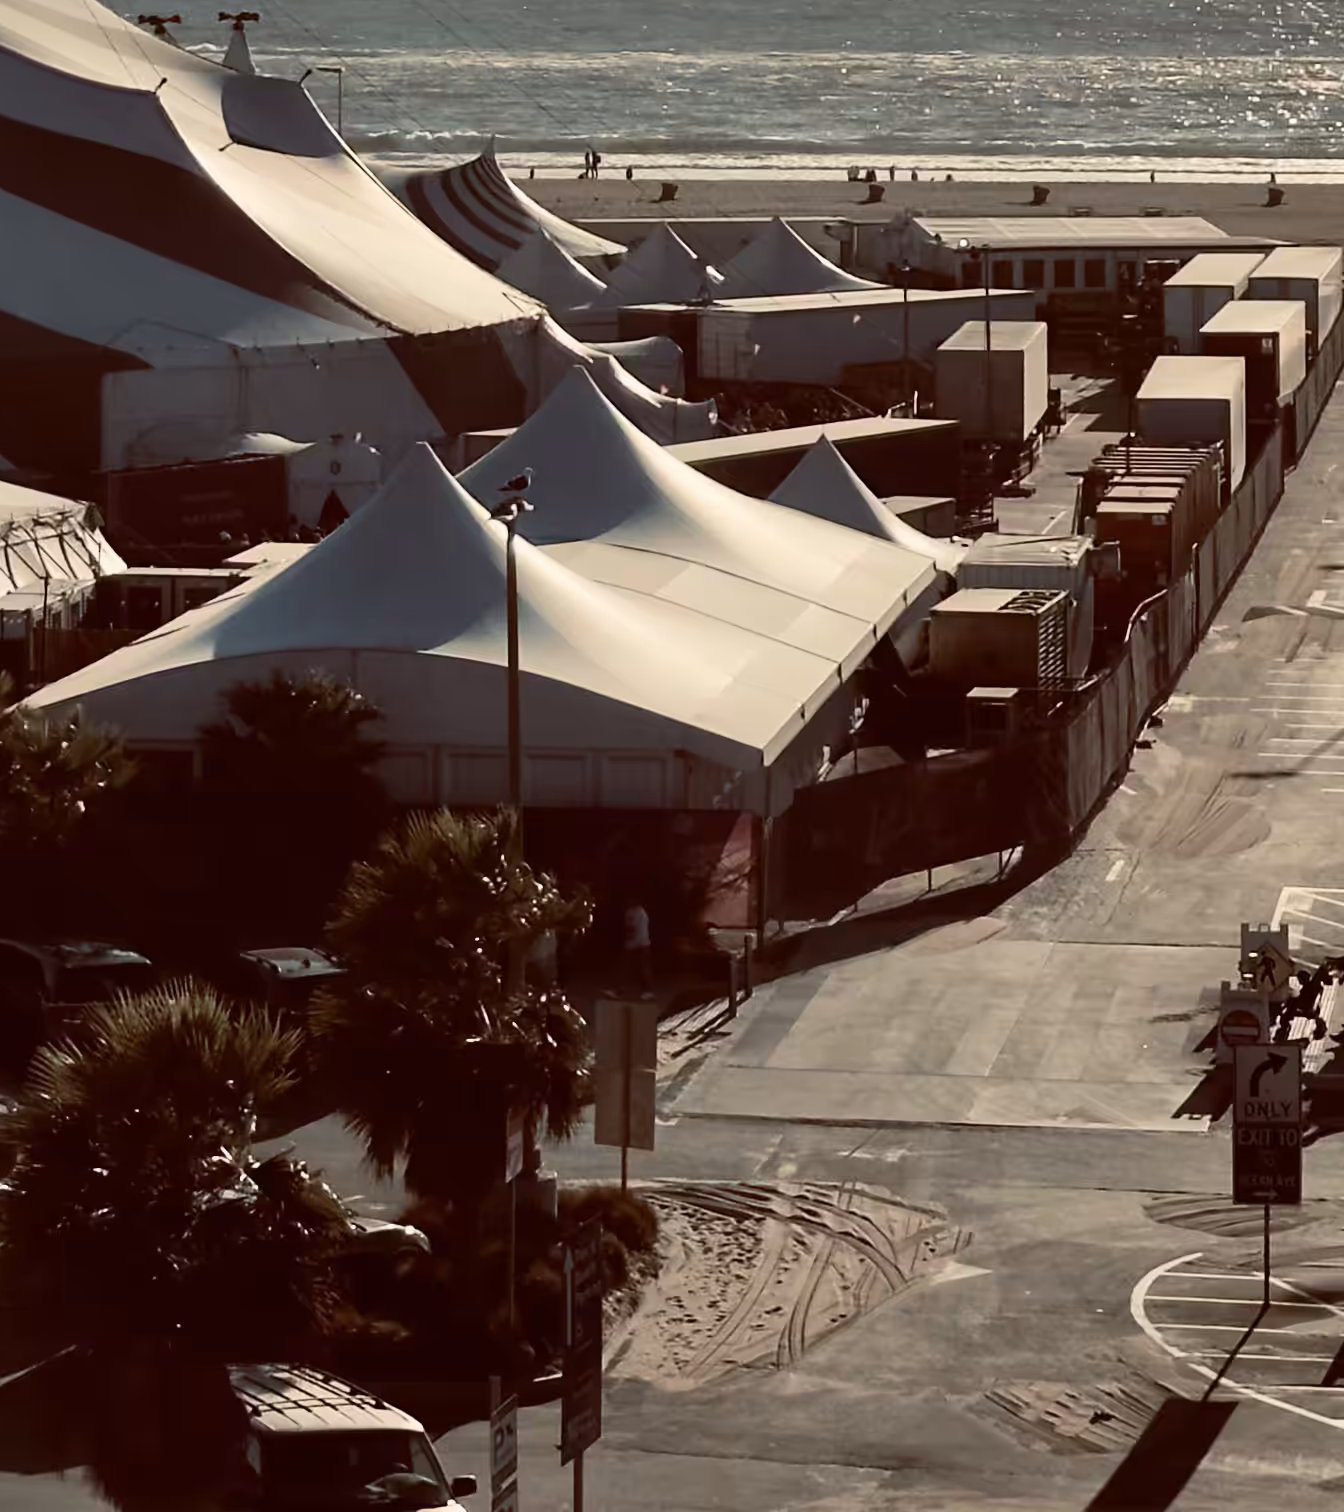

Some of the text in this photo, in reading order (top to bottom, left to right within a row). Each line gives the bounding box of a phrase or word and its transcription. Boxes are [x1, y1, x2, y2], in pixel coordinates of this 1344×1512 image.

[1245, 1101, 1293, 1118] ONLY
[1238, 1127, 1298, 1147] EXIT TO
